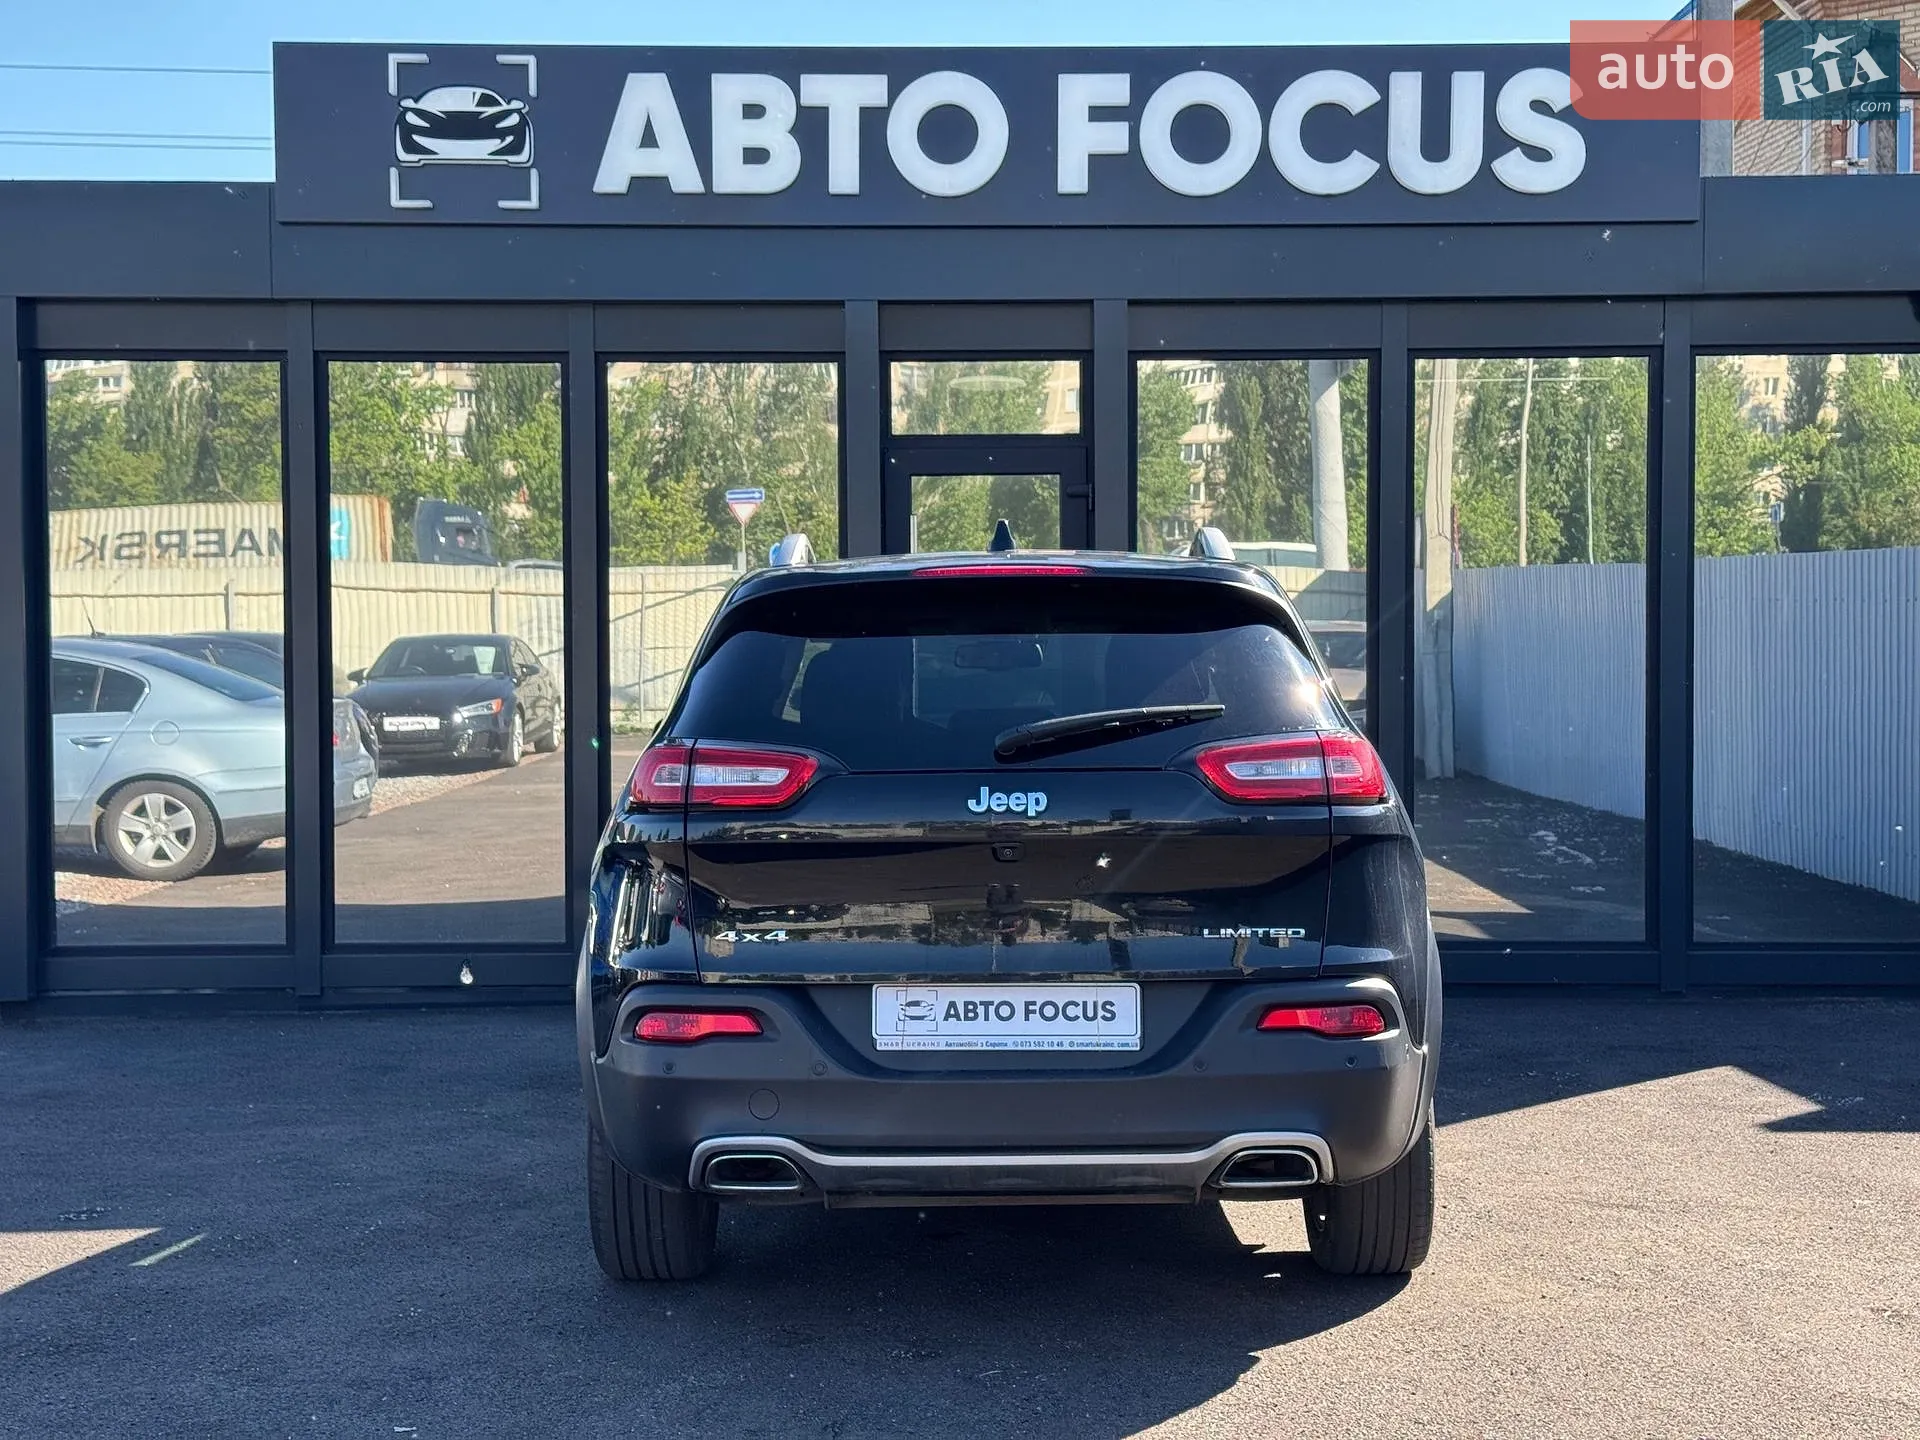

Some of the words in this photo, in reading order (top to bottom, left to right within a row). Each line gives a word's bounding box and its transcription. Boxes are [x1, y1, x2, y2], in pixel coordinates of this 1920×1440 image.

[1057, 67, 1587, 197] FOCUS
[967, 786, 1048, 817] Jeep
[715, 930, 789, 942] 4x4
[1203, 927, 1306, 938] LIMITED
[1023, 1000, 1117, 1022] FOCUS
